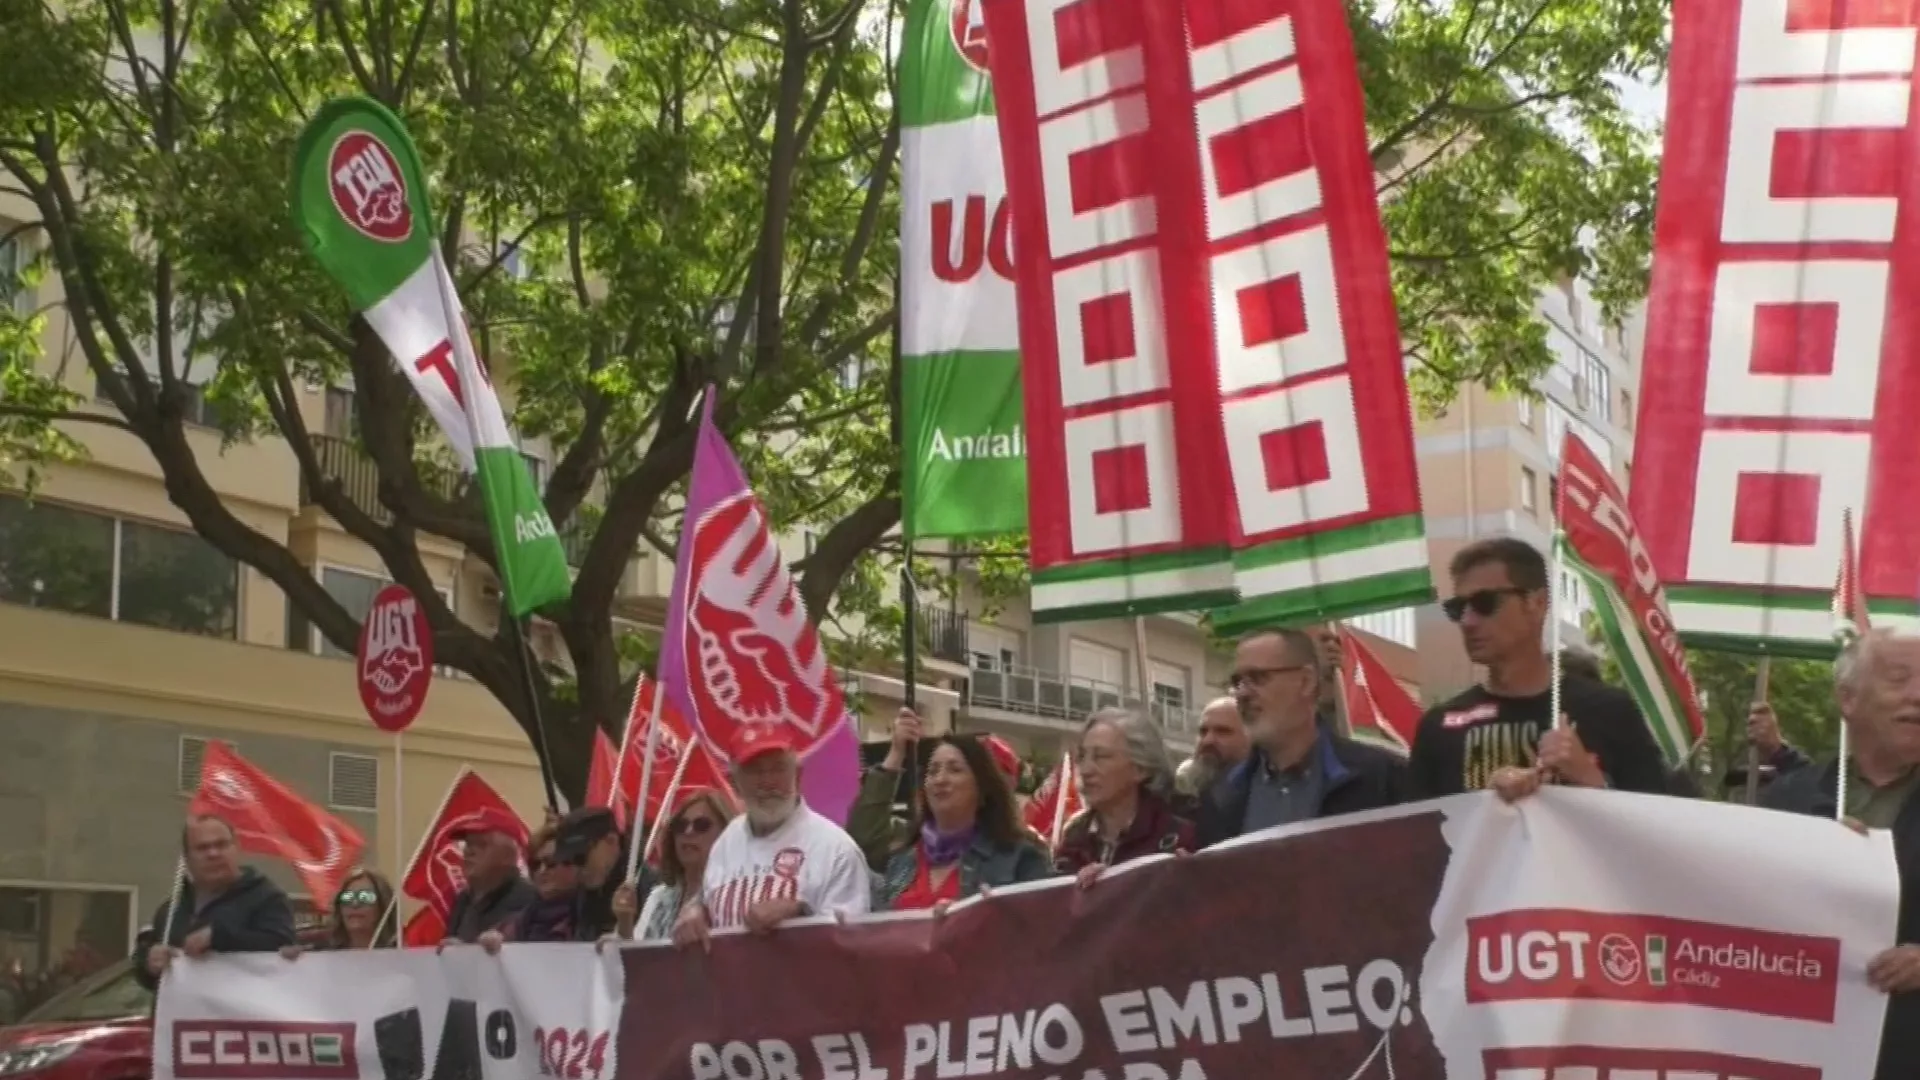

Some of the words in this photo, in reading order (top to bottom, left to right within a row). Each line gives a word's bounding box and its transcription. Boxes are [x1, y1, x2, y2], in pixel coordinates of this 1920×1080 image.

[926, 423, 1028, 461] Andal
[366, 598, 418, 660] UGT
[1478, 930, 1590, 983] UGT
[1674, 937, 1823, 978] Andalucía
[179, 1031, 310, 1065] CCOO
[690, 1038, 803, 1080] POR
[811, 1032, 888, 1080] EL
[903, 1002, 1084, 1080] PLENO
